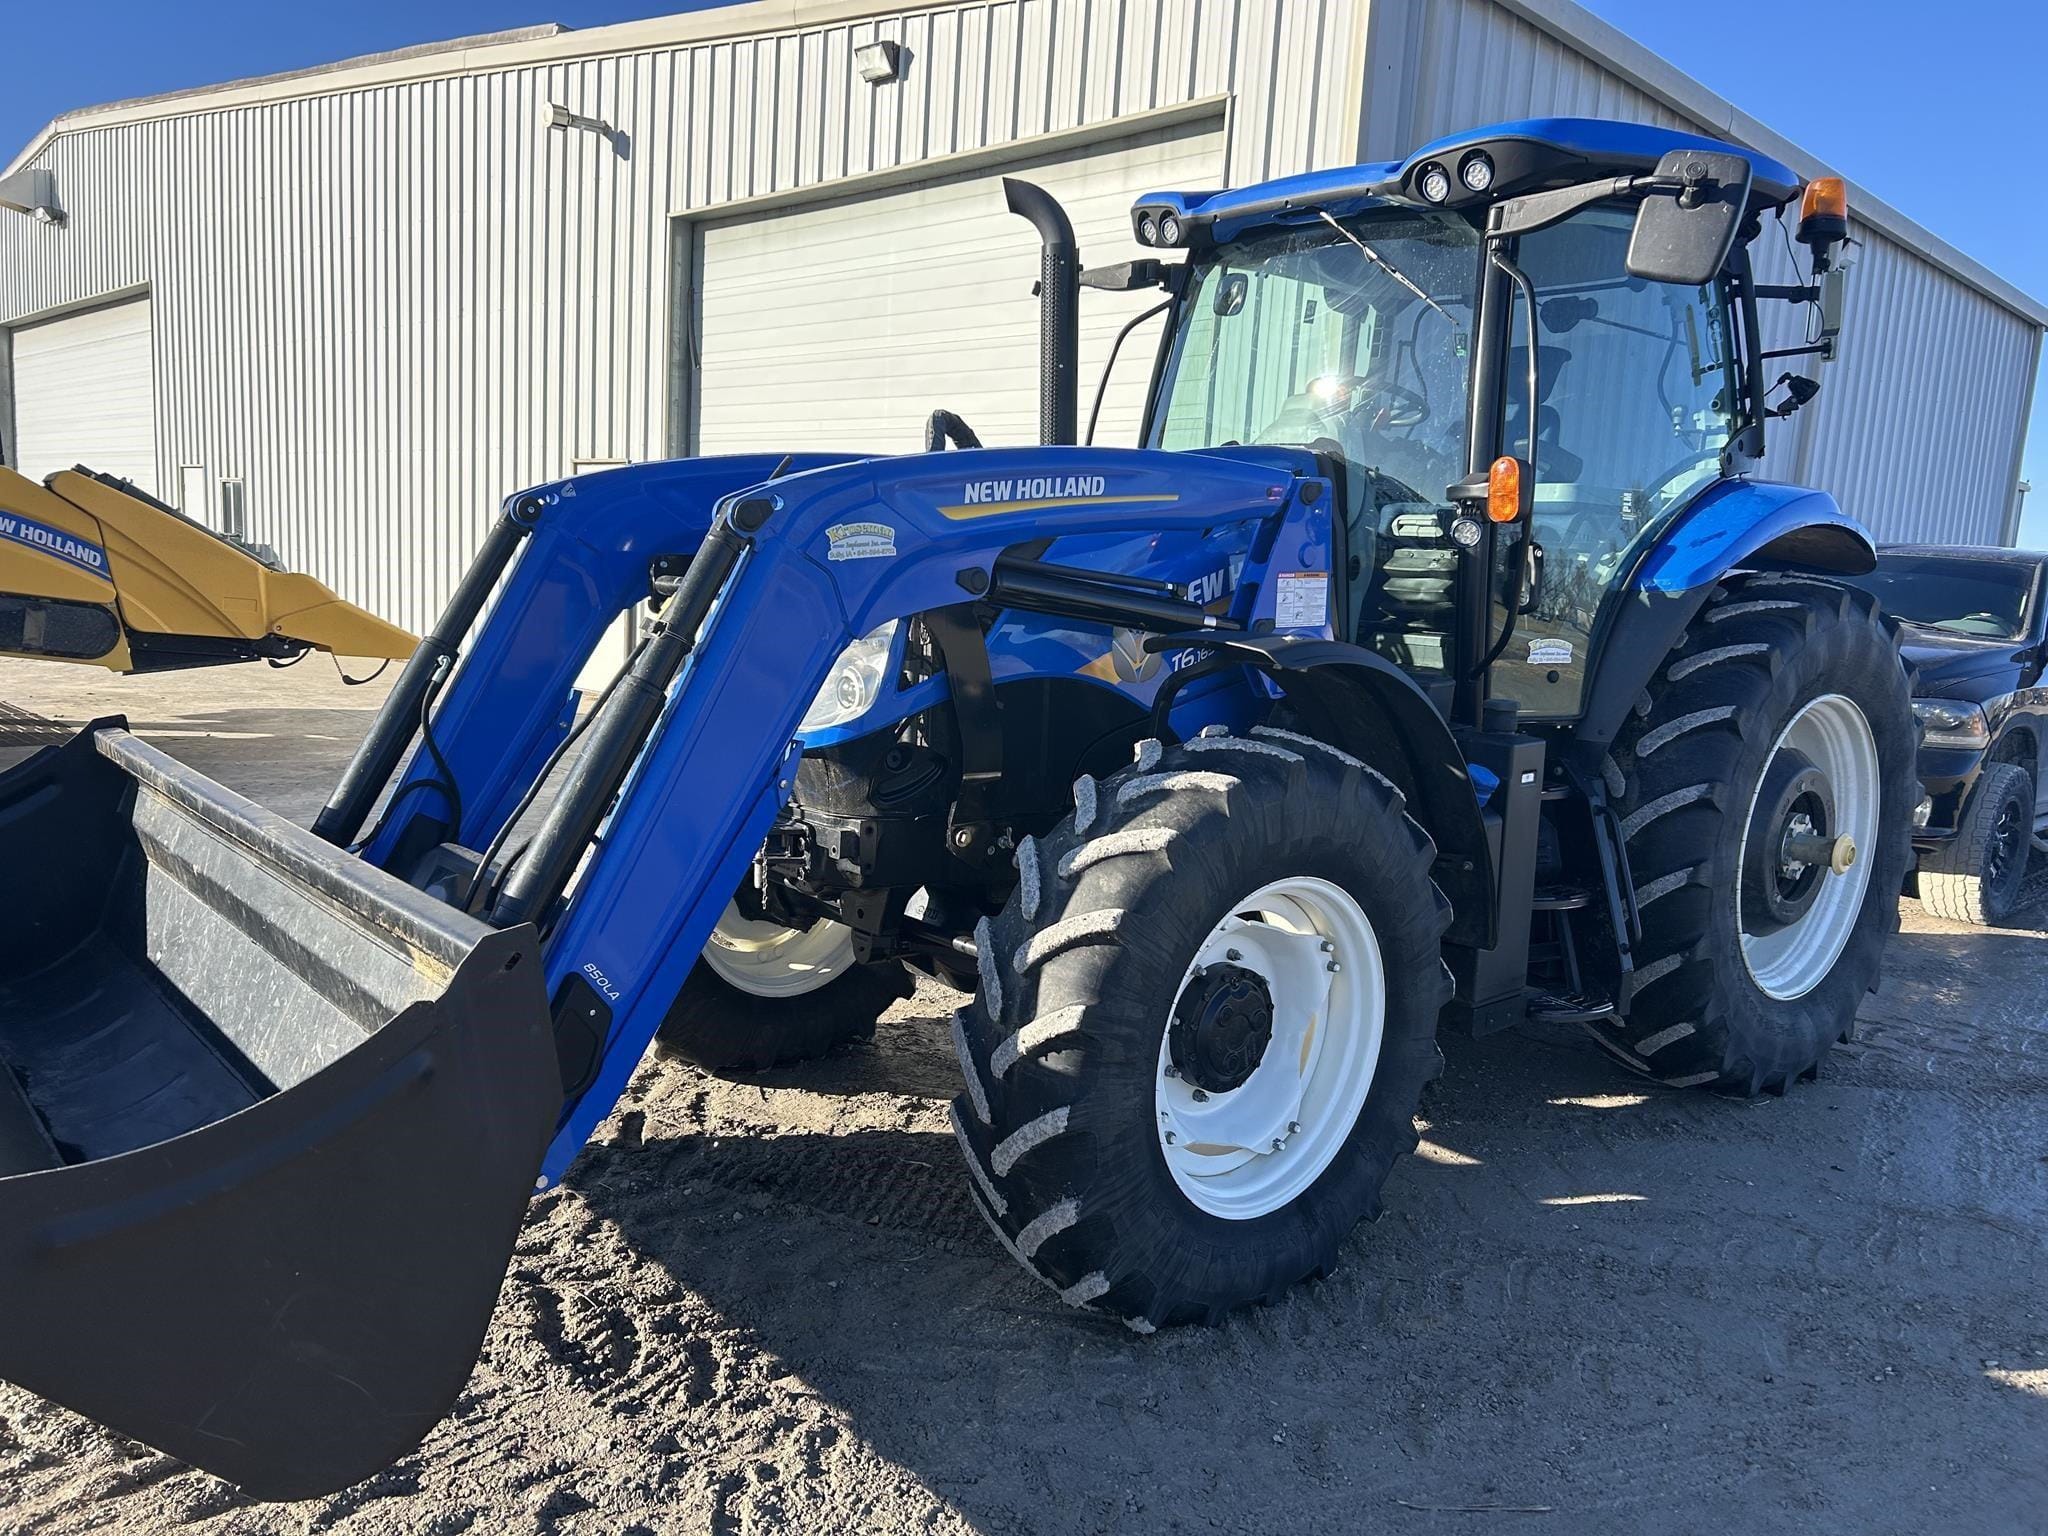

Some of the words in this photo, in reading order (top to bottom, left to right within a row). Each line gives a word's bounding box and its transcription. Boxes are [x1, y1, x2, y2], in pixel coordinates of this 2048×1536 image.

[964, 480, 1012, 504] NEW
[1016, 476, 1105, 500] HOLLAND
[20, 523, 101, 567] HOLLAND
[1184, 569, 1224, 606] EW
[583, 963, 620, 1001] 850LA
